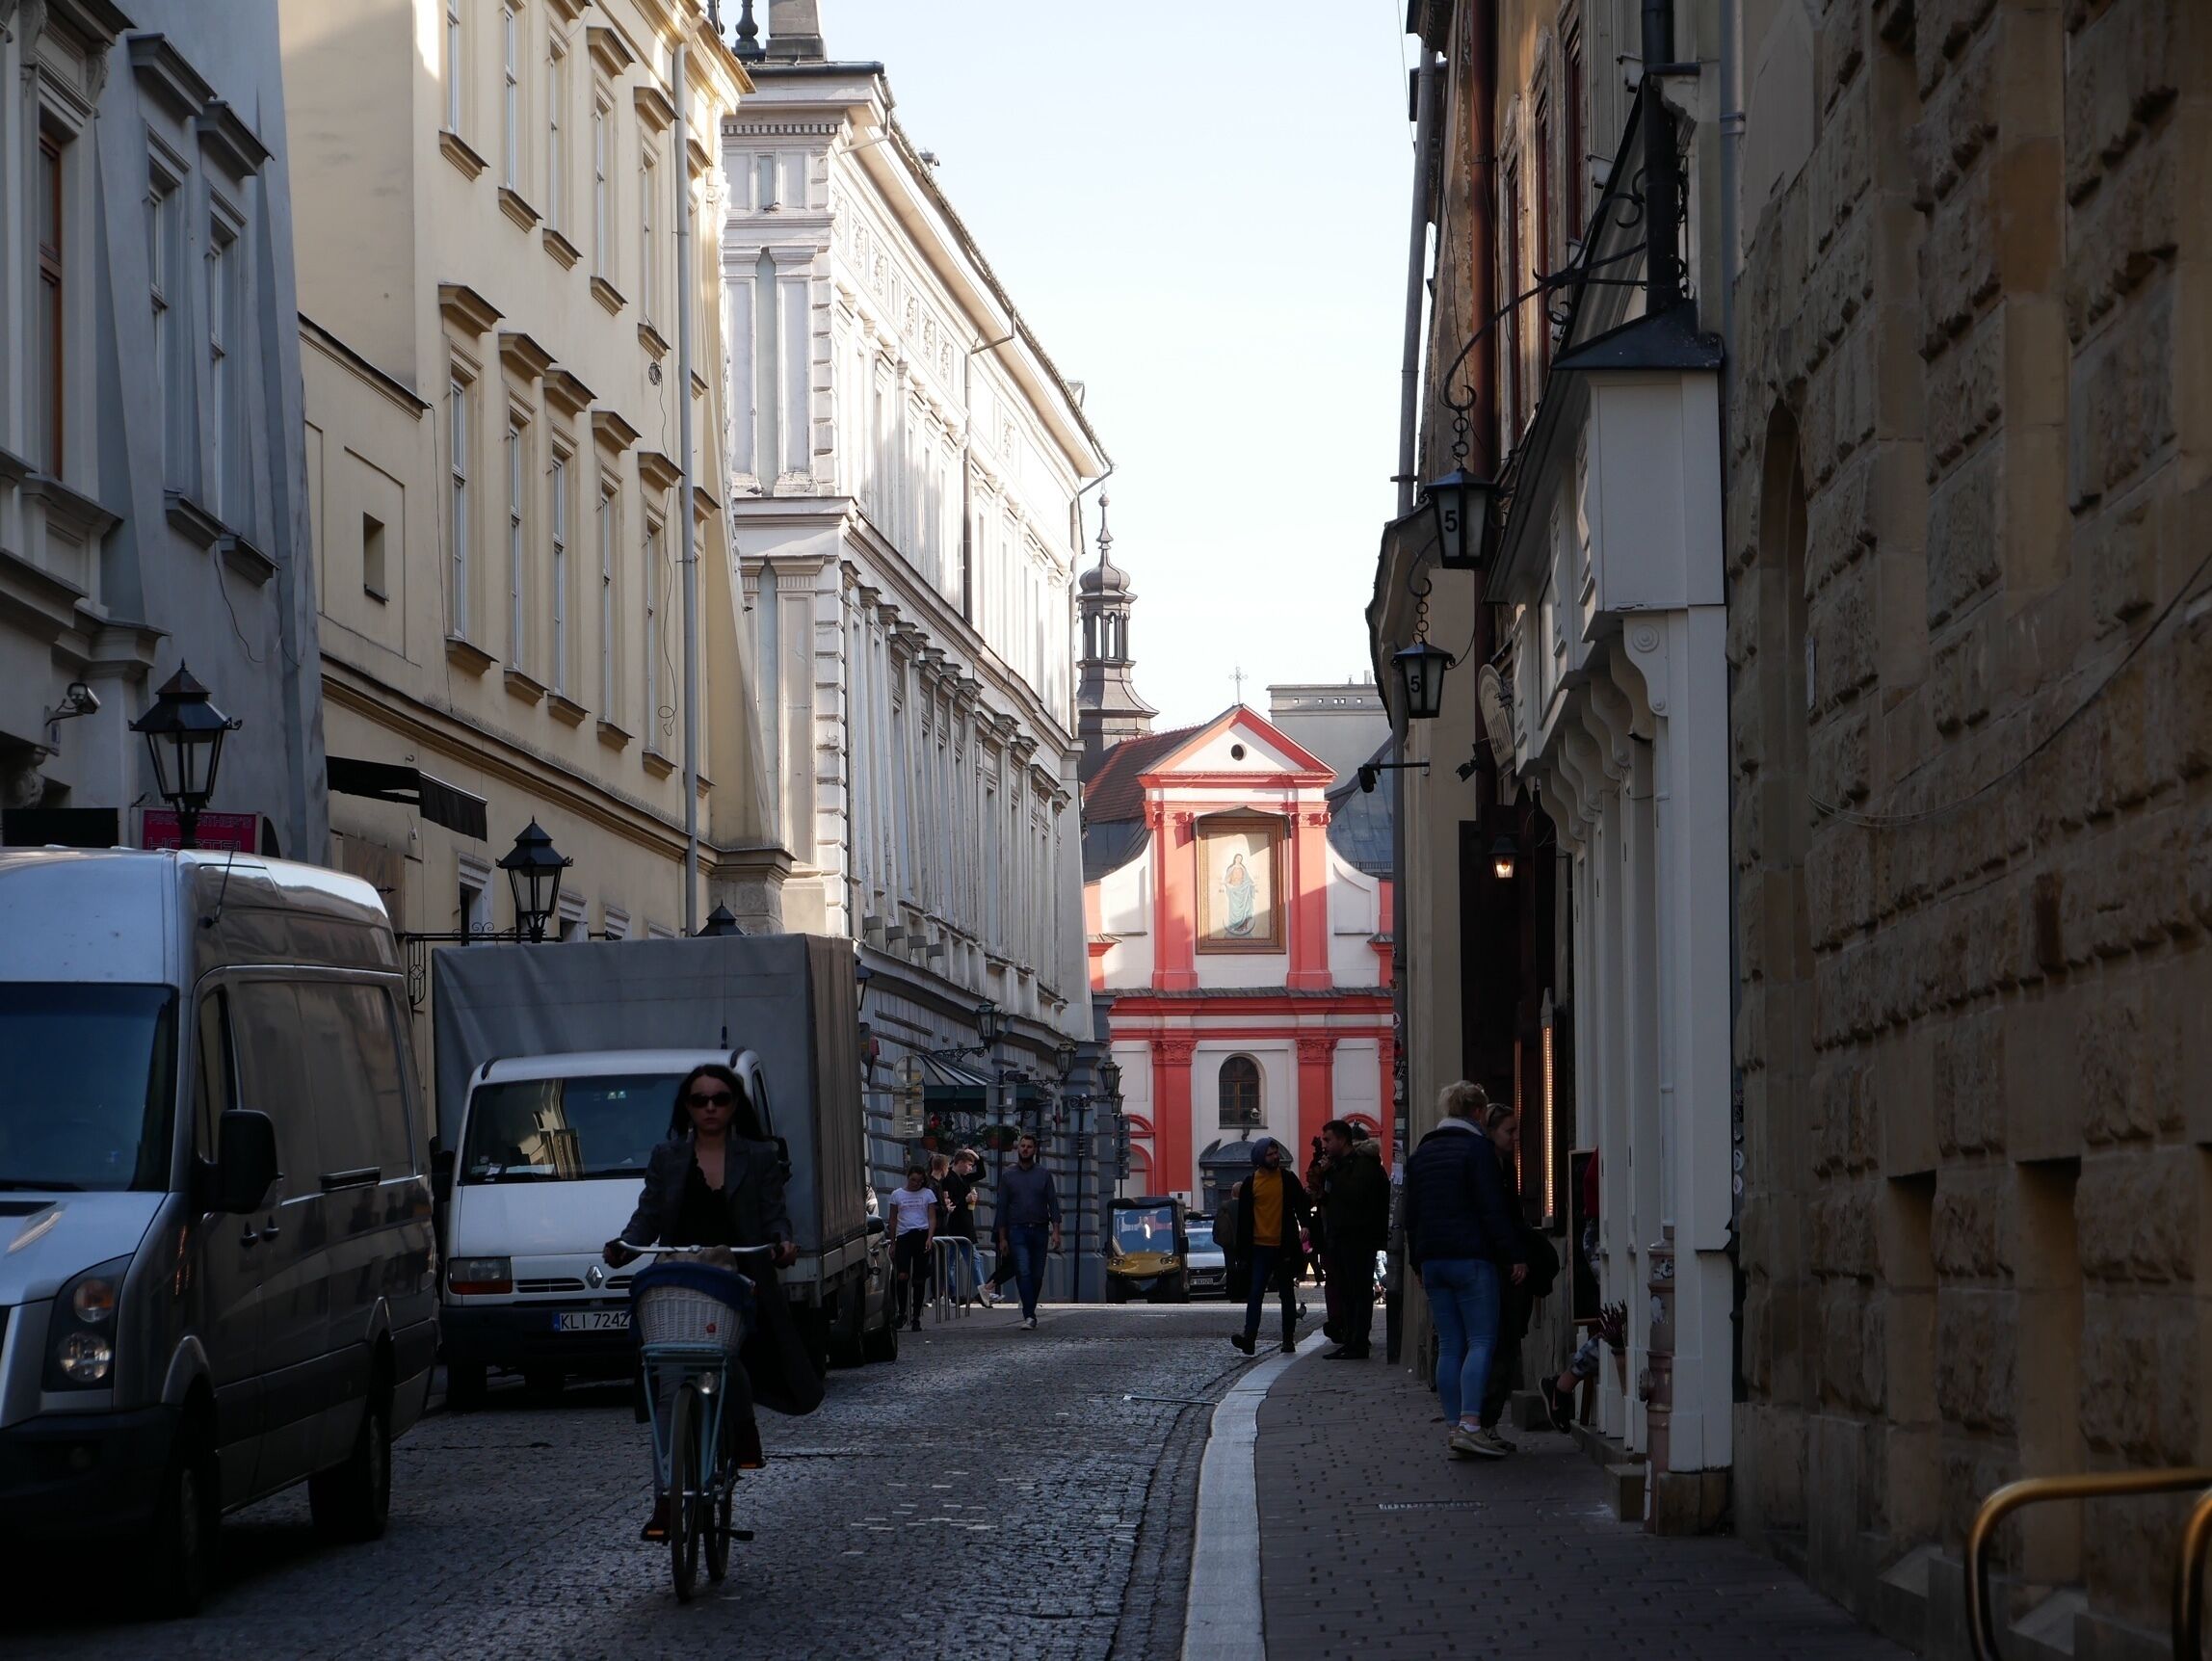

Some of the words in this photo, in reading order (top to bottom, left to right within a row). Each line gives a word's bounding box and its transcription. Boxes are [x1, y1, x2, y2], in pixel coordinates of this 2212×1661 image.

[1444, 510, 1459, 533] 5
[1409, 675, 1421, 693] 5
[561, 1314, 586, 1330] KLI
